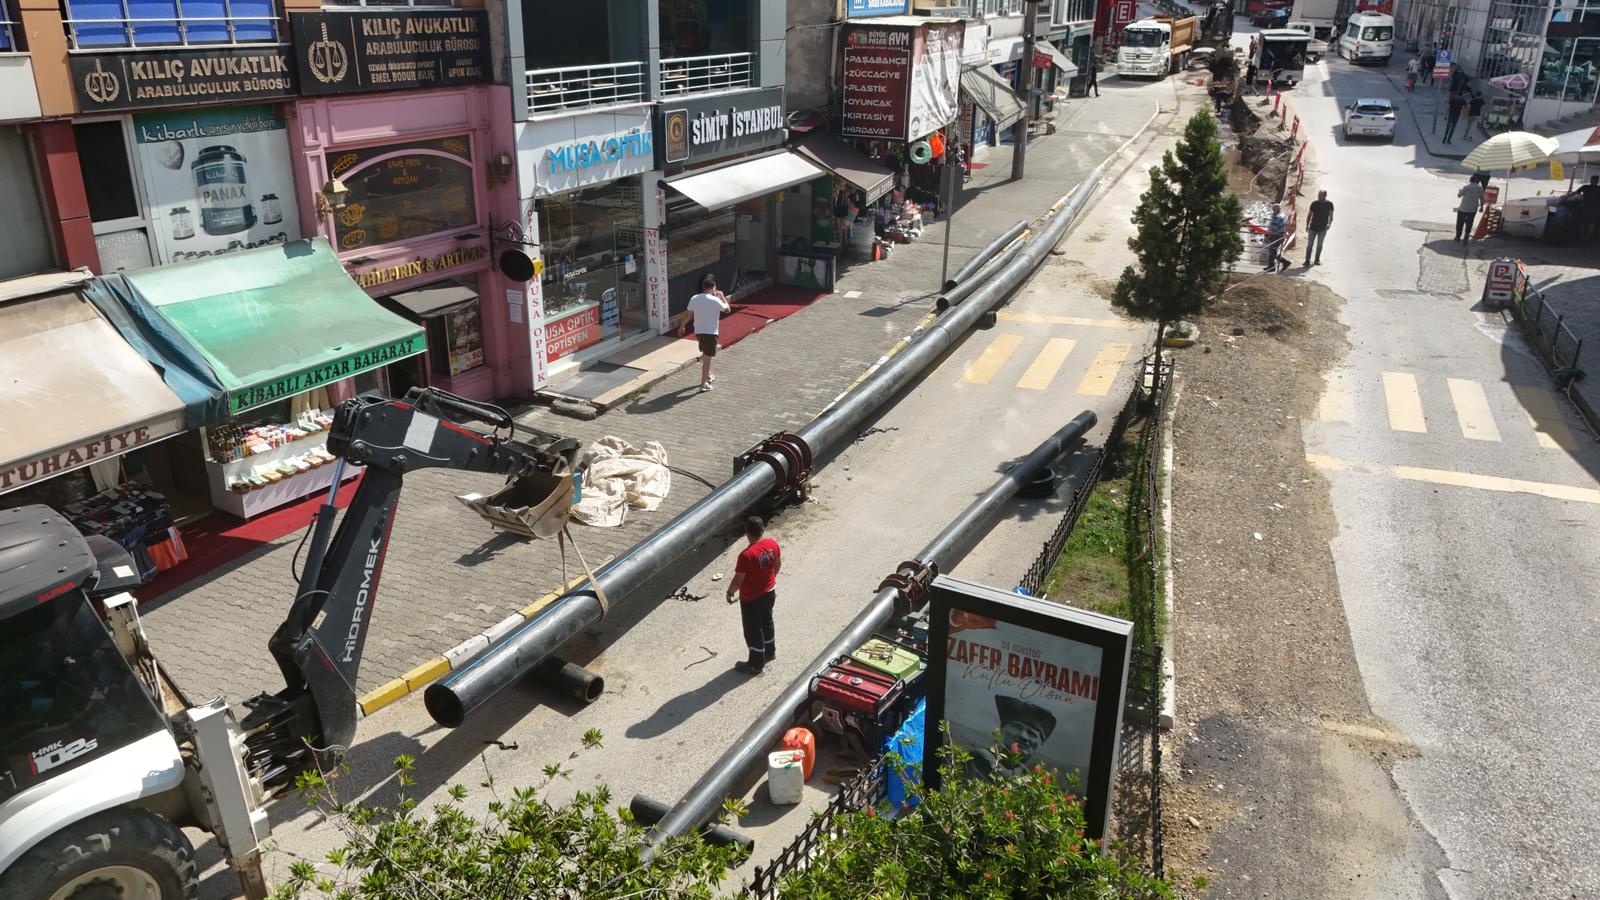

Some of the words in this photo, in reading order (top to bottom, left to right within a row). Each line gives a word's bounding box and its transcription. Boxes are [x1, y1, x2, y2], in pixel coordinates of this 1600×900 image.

[361, 18, 401, 39] KILIÇ
[405, 16, 479, 34] AVUKATLIK
[365, 40, 443, 56] ARABULUCULUK
[444, 37, 481, 51] BÜROSU
[888, 32, 910, 46] AVM
[131, 59, 184, 82] KILIÇ
[190, 55, 289, 77] AVUKATLIK
[849, 55, 907, 67] PAŞABAHÇE
[371, 72, 391, 83] EMEL
[392, 71, 416, 82] BODUR
[417, 69, 435, 82] KILIÇ
[448, 67, 465, 78] UFUK
[848, 68, 901, 79] ZÜCCACİYE
[136, 80, 242, 99] ARABULUCULUK
[243, 77, 292, 92] BÜROSU
[848, 83, 887, 93] PLASTİK
[847, 98, 892, 108] OYUNCAK
[692, 109, 729, 145] SİMİT
[731, 106, 784, 138] İSTANBUL
[847, 111, 894, 122] KIRTASİYE
[141, 120, 207, 143] kibarlı
[846, 125, 890, 135] HIRDAVAT
[548, 139, 603, 175] MUSA
[203, 186, 247, 204] PANAX
[647, 230, 657, 265] MUSA
[1497, 266, 1507, 277] P
[529, 275, 541, 319] MUSA
[544, 324, 565, 341] USA
[566, 309, 596, 331] OPTİK
[547, 330, 589, 355] OPTİSYEN
[237, 377, 301, 410] KİBARLI
[303, 360, 350, 388] AKTAR
[353, 339, 414, 371] BAHARAT
[0, 425, 150, 489] TUHAFİYE
[947, 636, 1003, 671] ZAFER
[1007, 652, 1100, 701] BAYRAMI
[31, 740, 64, 759] HMK
